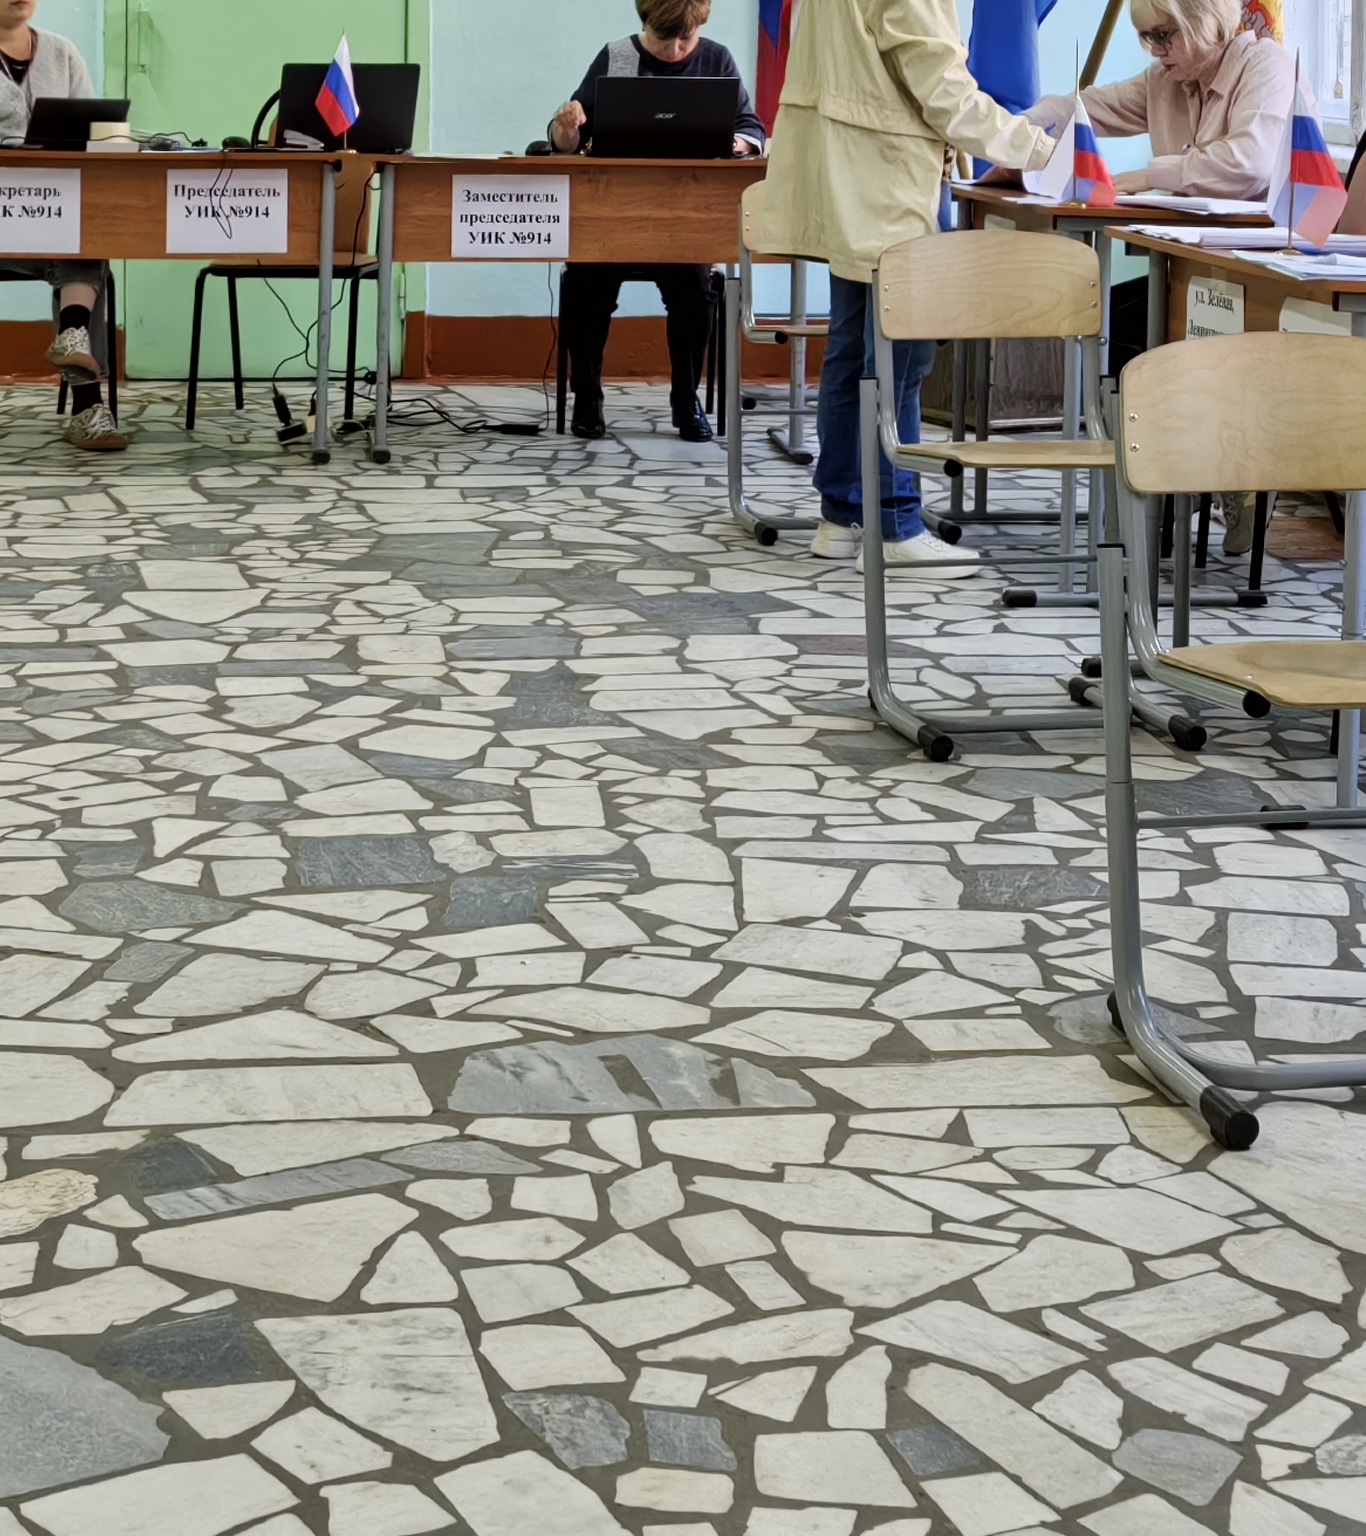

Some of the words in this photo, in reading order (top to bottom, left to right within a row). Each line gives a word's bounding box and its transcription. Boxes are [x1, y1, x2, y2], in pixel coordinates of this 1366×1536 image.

[175, 184, 281, 200] Председатель
[463, 189, 558, 203] Заместитель
[18, 204, 62, 218] №914
[185, 205, 221, 219] УИК
[225, 205, 270, 219] №914
[460, 214, 560, 226] председателя
[469, 232, 506, 245] УИК
[509, 232, 552, 245] №914
